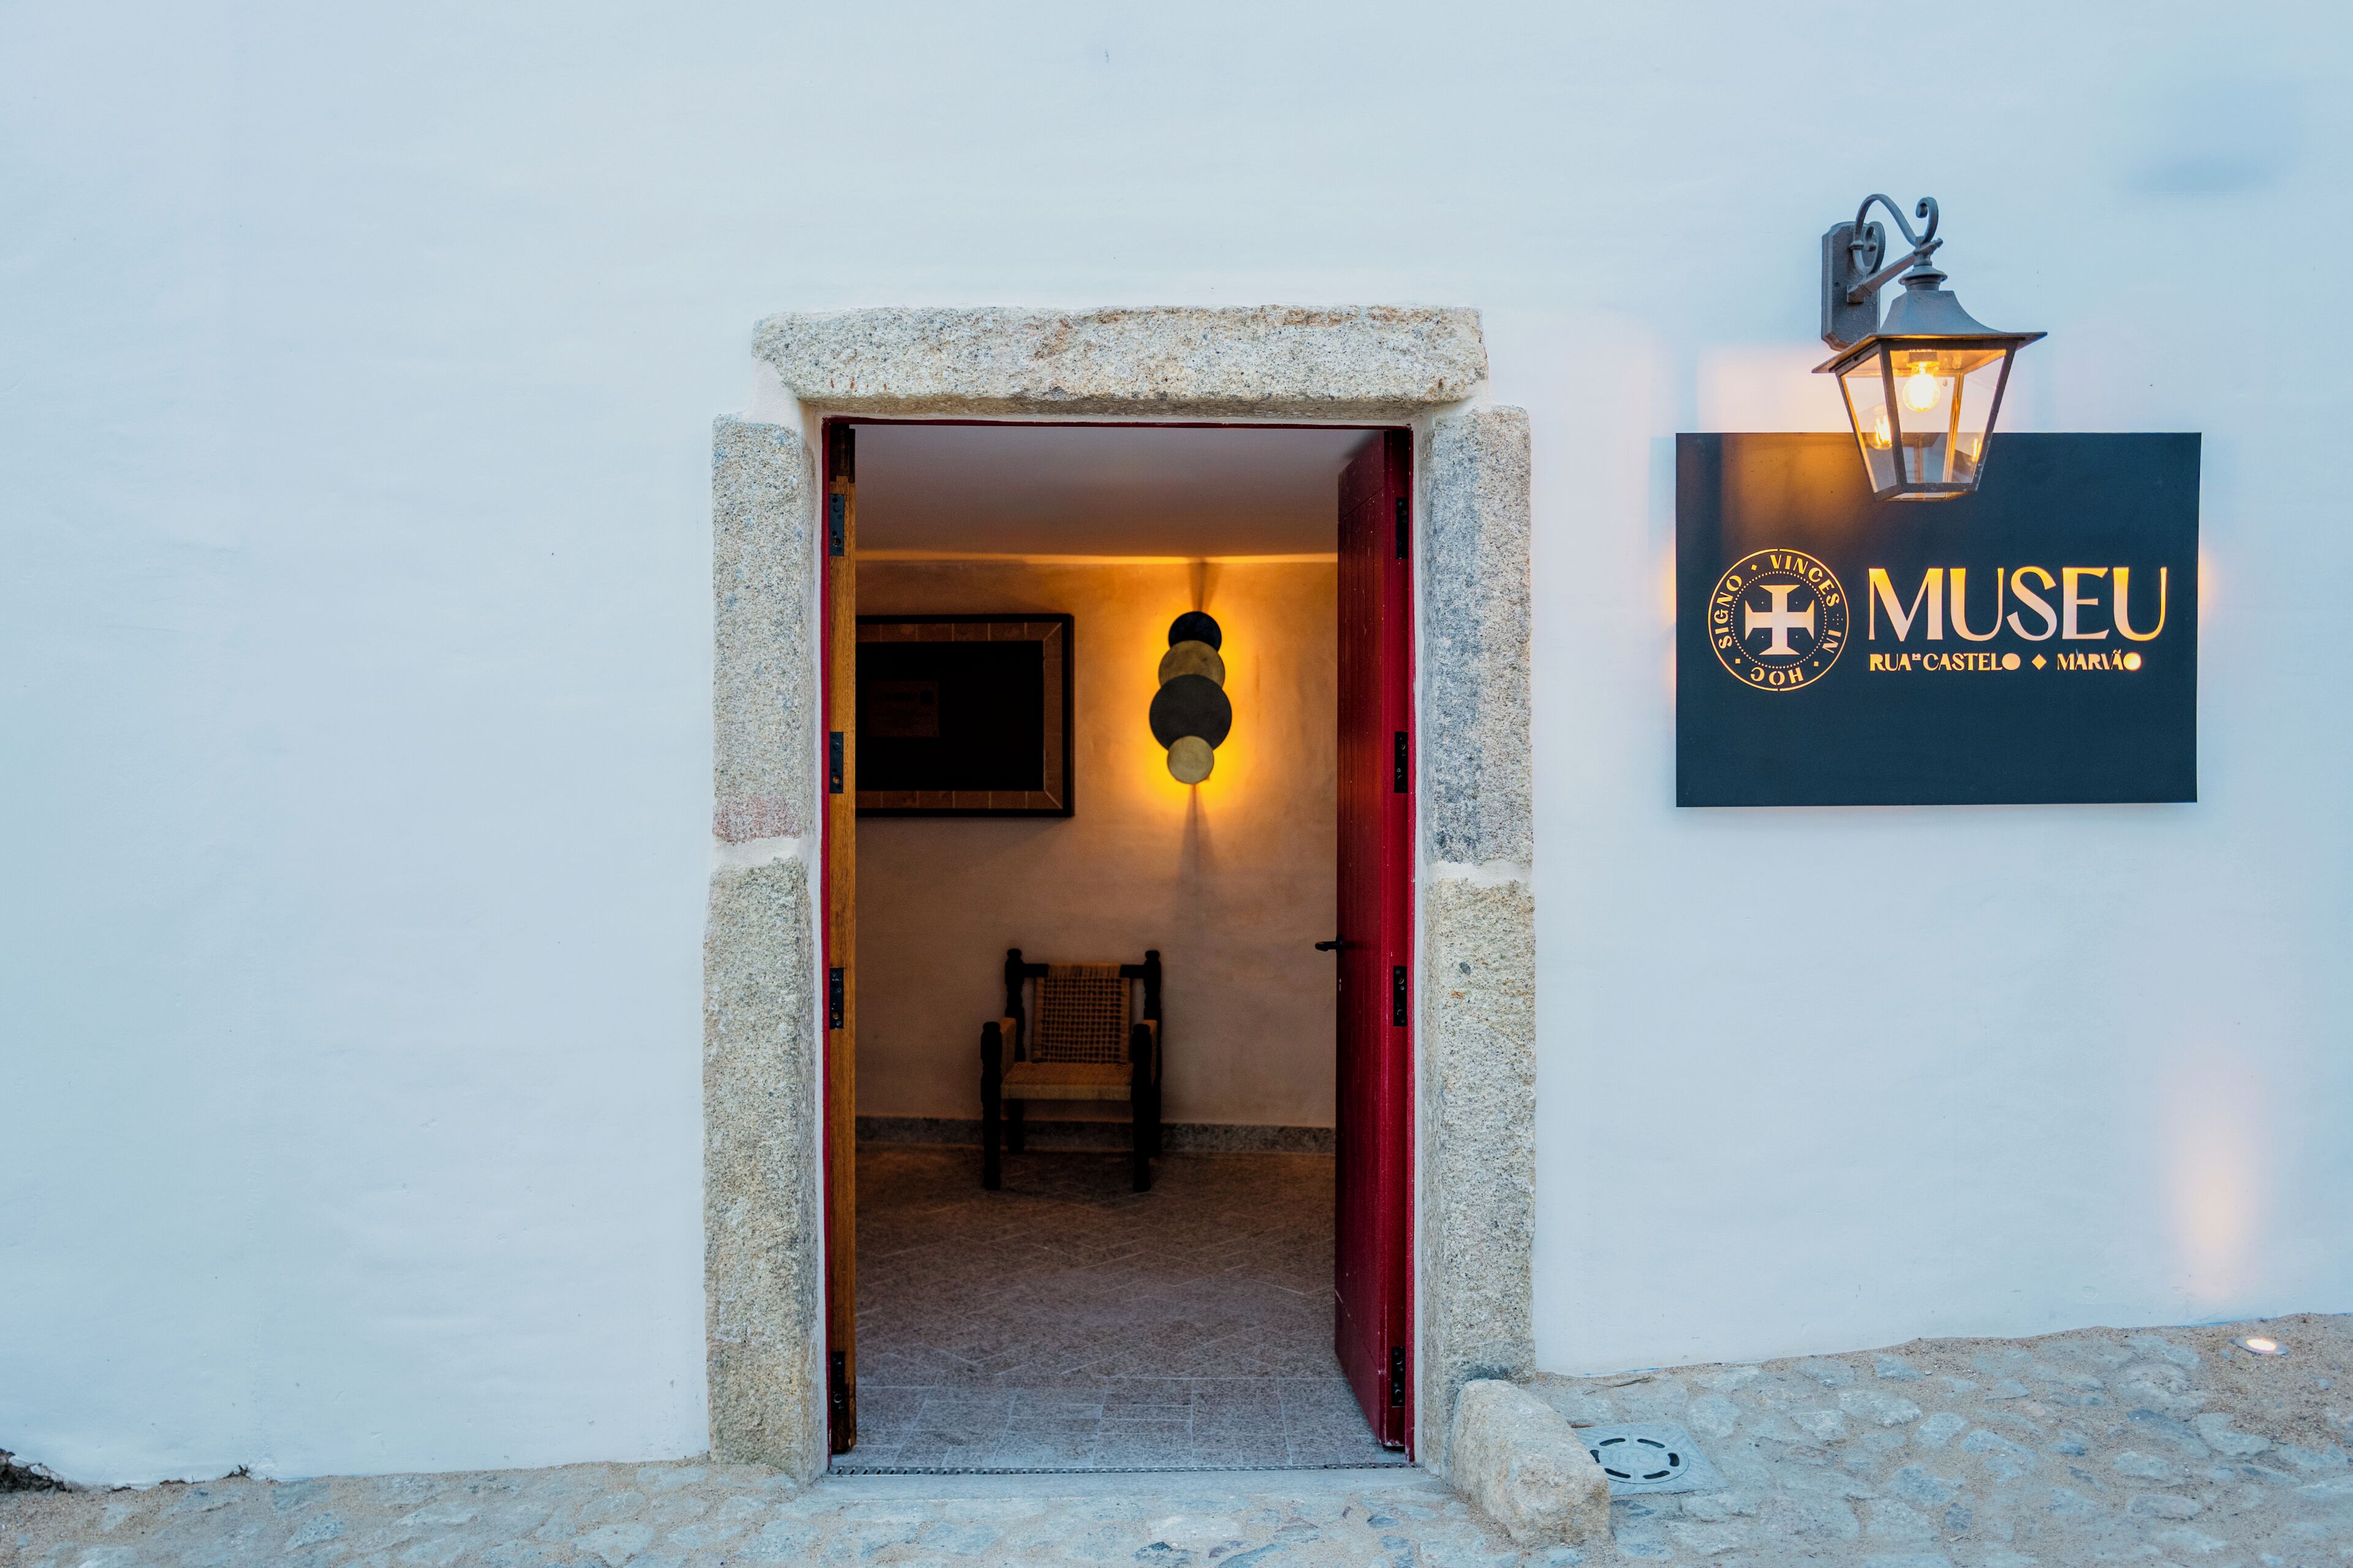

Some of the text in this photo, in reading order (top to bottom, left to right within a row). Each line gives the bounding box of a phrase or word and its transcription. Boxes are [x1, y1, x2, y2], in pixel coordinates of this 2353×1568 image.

[1714, 554, 1842, 686] IN HOC SIGNO VINCES
[1868, 566, 2168, 642] MUSEU
[1870, 653, 1912, 672] RUA
[1922, 653, 2021, 672] CASTELO
[2056, 648, 2142, 672] MARVÃO
